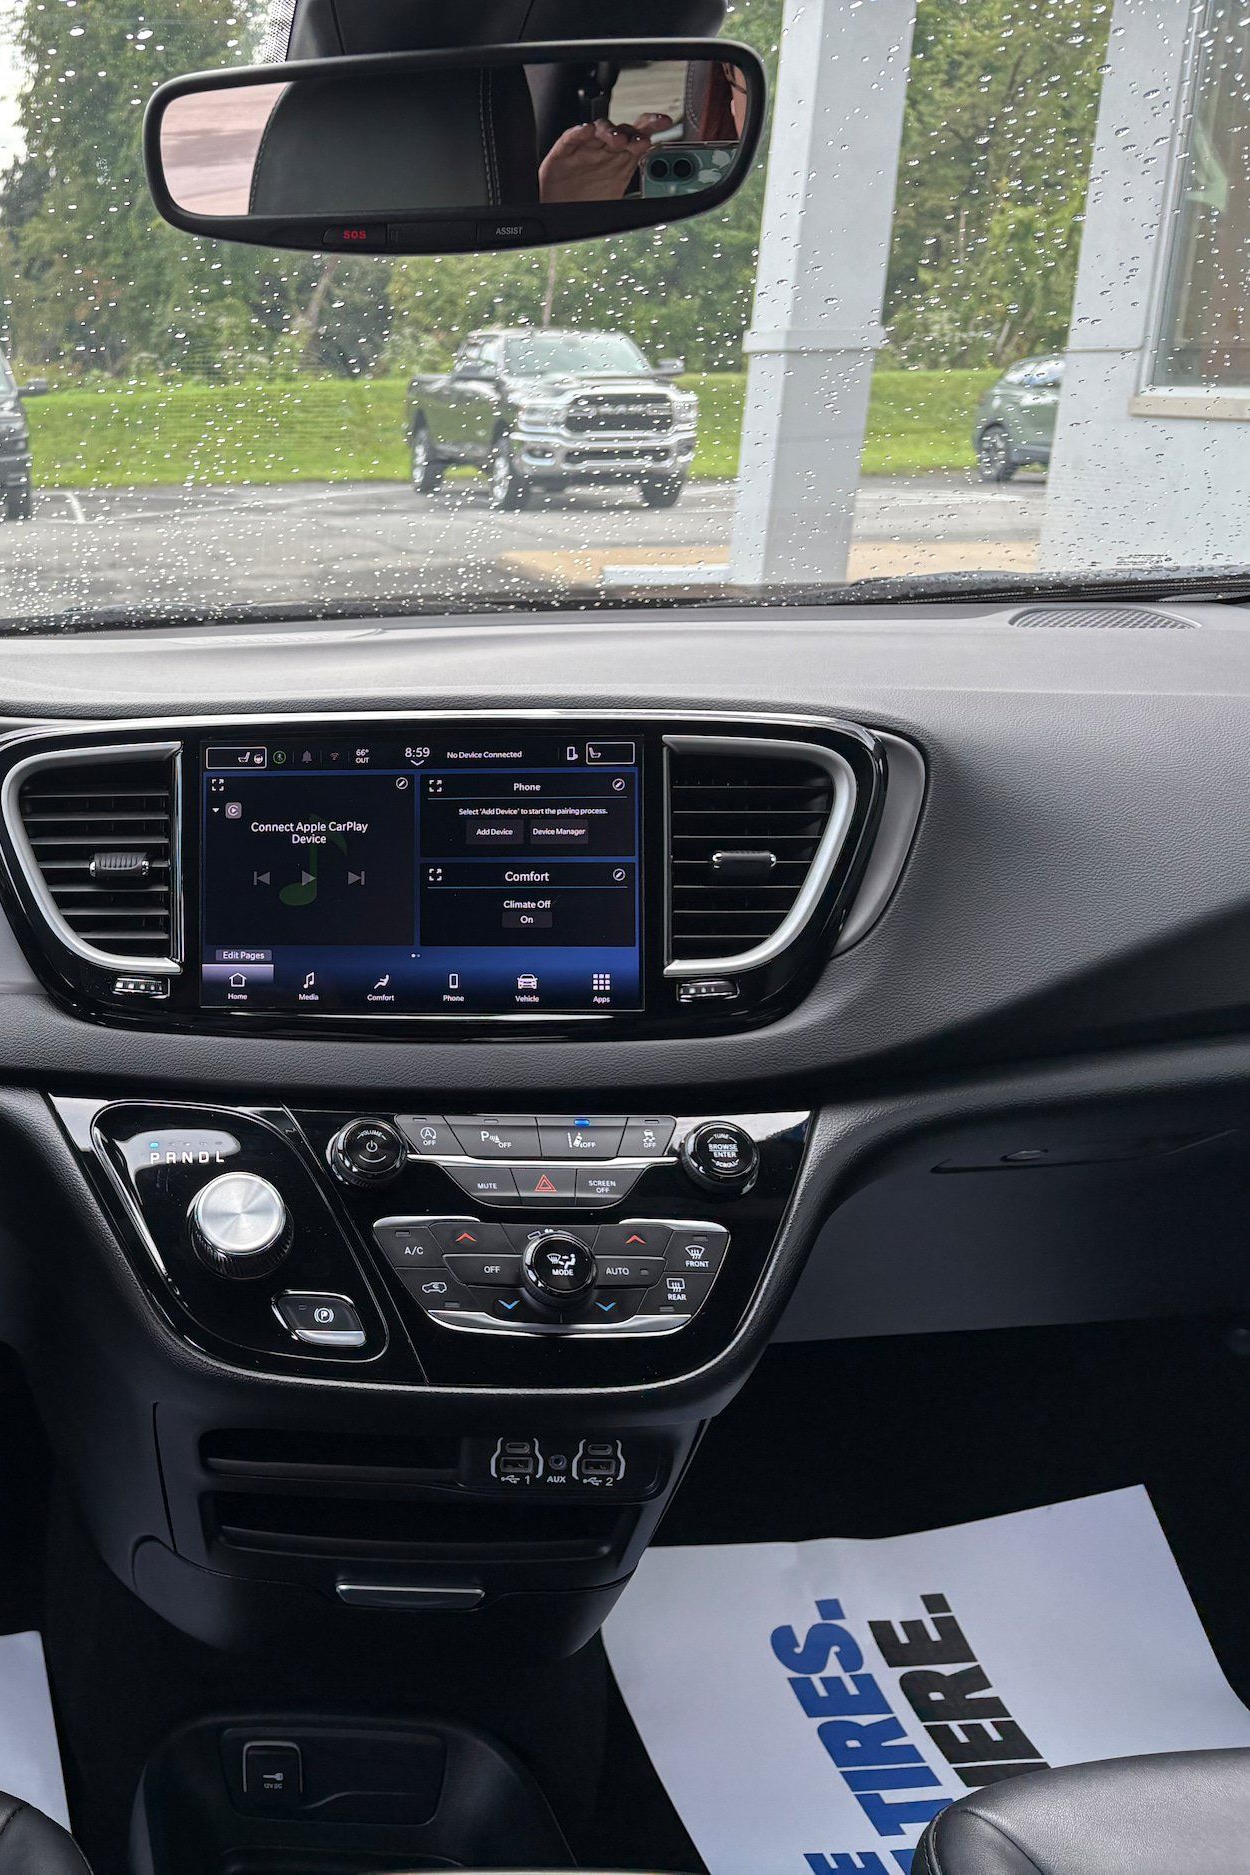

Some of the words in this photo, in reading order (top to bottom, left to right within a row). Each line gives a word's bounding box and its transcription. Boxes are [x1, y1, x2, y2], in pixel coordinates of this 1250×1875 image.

[343, 230, 367, 240] SOS
[495, 226, 523, 236] ASSIST
[404, 747, 430, 758] 8:59
[447, 751, 458, 759] No
[458, 751, 482, 759] Device
[513, 783, 541, 791] Phone
[557, 808, 579, 816] pairing
[250, 821, 294, 832] Connect
[296, 821, 326, 833] Apple
[328, 821, 368, 833] CarPlay
[556, 828, 586, 836] Manager
[291, 834, 327, 844] Device
[504, 871, 550, 881] Comfort
[503, 900, 536, 908] Climate
[537, 900, 551, 909] Off
[520, 915, 534, 924] On
[223, 951, 239, 959] Edit
[240, 951, 265, 961] Pages
[298, 993, 319, 1001] Media
[443, 994, 465, 1002] Phone
[515, 995, 539, 1003] Vehicle
[593, 995, 610, 1004] Apps
[404, 1246, 424, 1255] A/C
[524, 1476, 530, 1485] 1
[605, 1478, 613, 1486] 2
[770, 1598, 953, 1837] TIRES.
